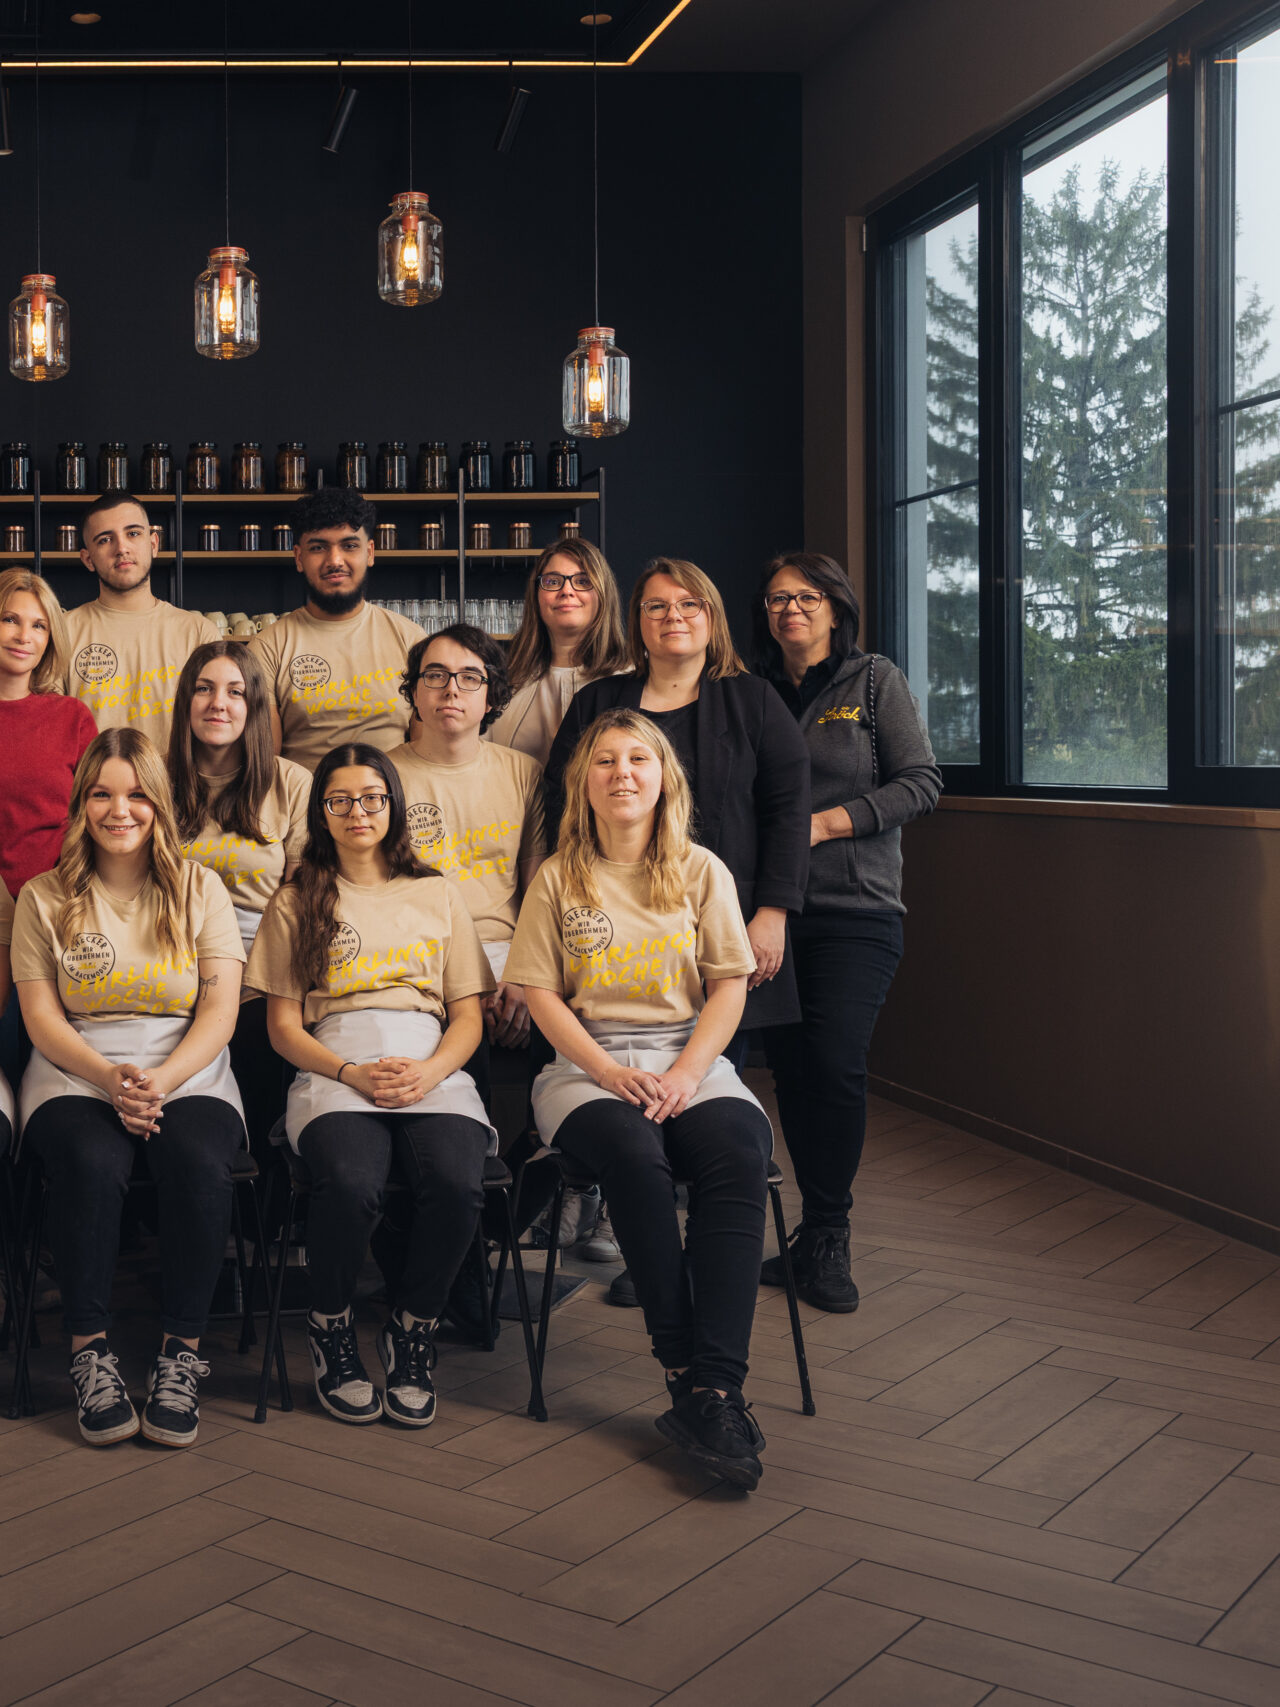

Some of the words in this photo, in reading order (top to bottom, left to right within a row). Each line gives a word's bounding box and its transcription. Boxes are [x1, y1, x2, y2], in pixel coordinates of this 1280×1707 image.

[80, 646, 112, 659] CHECKER
[92, 685, 151, 710] WOCHE
[128, 698, 174, 722] 2025
[306, 688, 372, 715] WOCHE
[347, 697, 398, 720] 2025
[224, 868, 265, 887] 025
[458, 856, 510, 881] 2025
[564, 909, 604, 927] CHECKER
[70, 936, 107, 952] CHECKER
[327, 939, 443, 983] EHRLINGS-
[582, 958, 663, 989] WOCHE
[83, 981, 168, 1011] WOCHE
[627, 968, 687, 999] 2025
